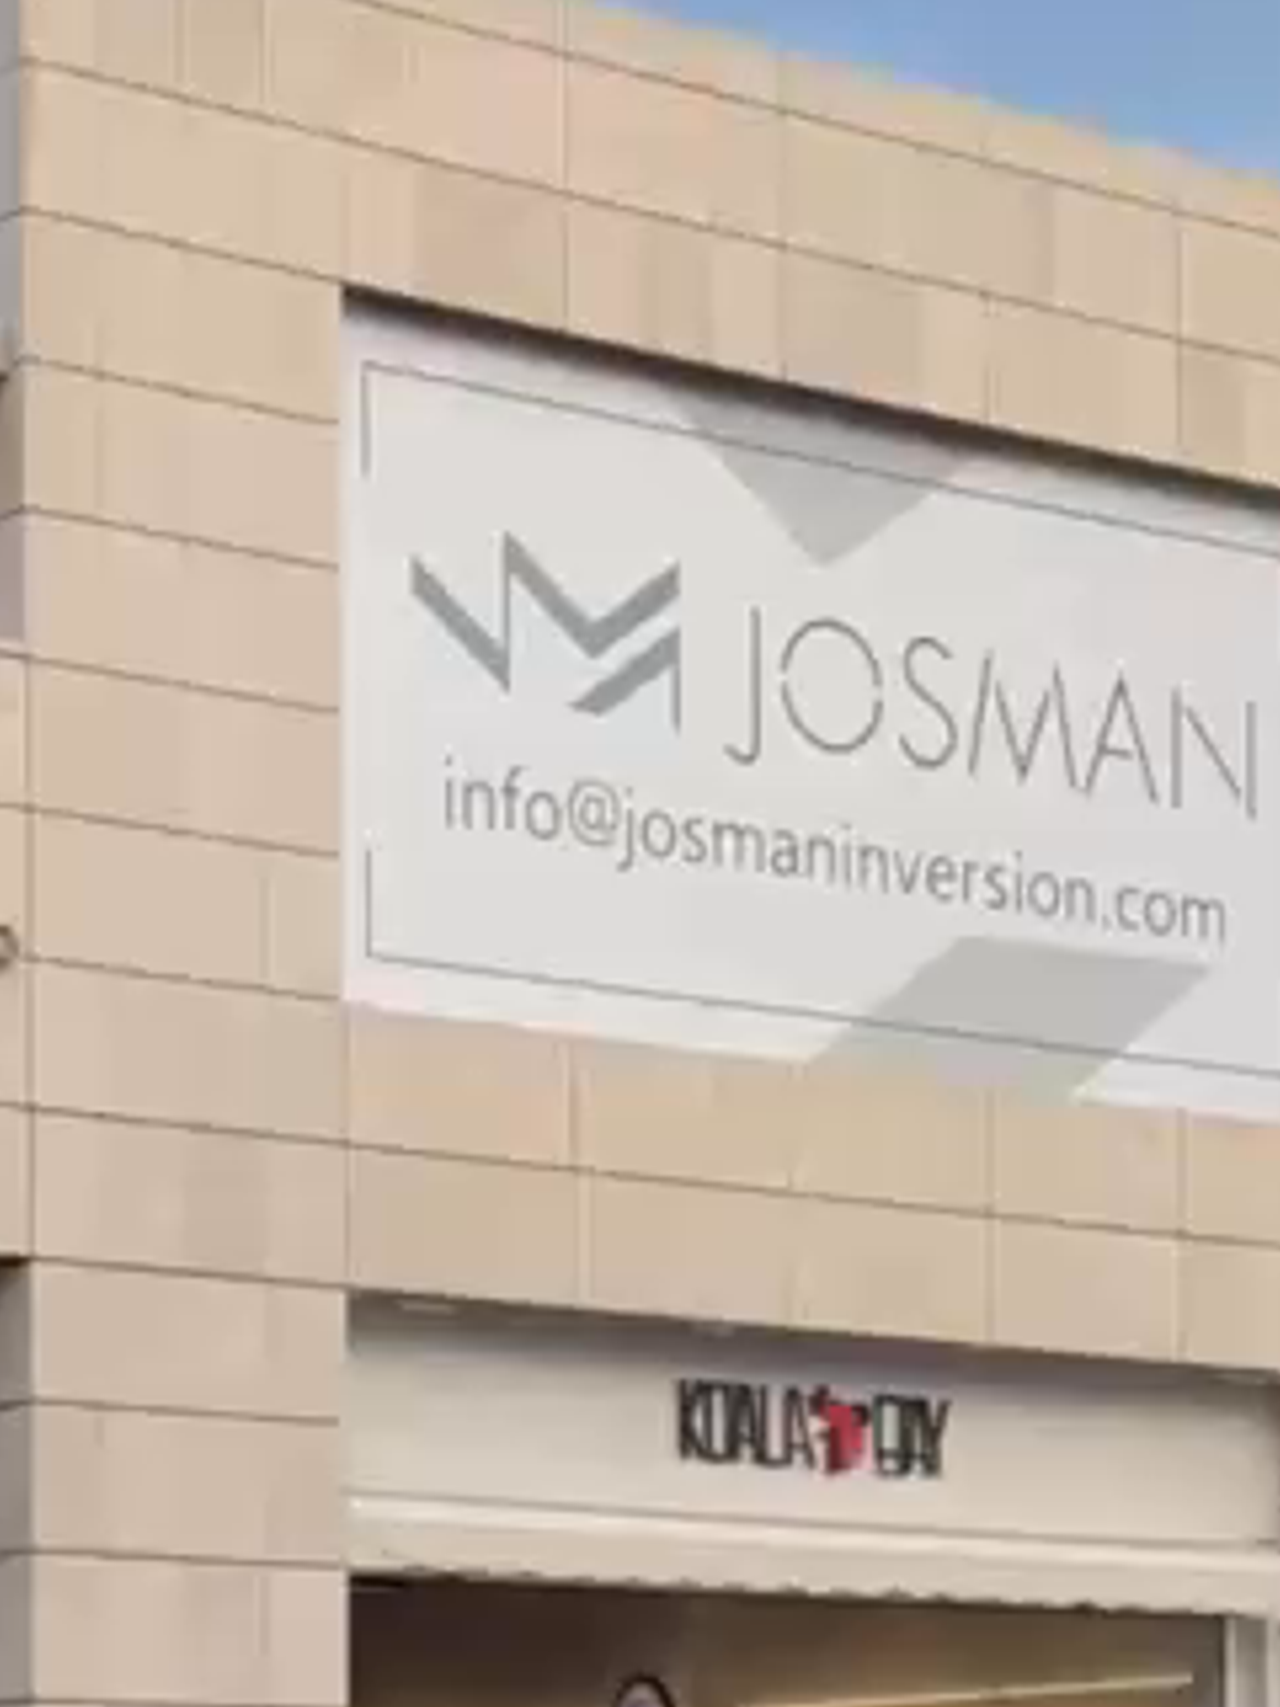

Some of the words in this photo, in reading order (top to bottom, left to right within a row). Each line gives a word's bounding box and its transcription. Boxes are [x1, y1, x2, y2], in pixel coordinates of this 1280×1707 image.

[722, 605, 1258, 820] JOSMAN
[442, 755, 1227, 945] info@josmaninversion.com
[677, 1377, 817, 1471] KOALA
